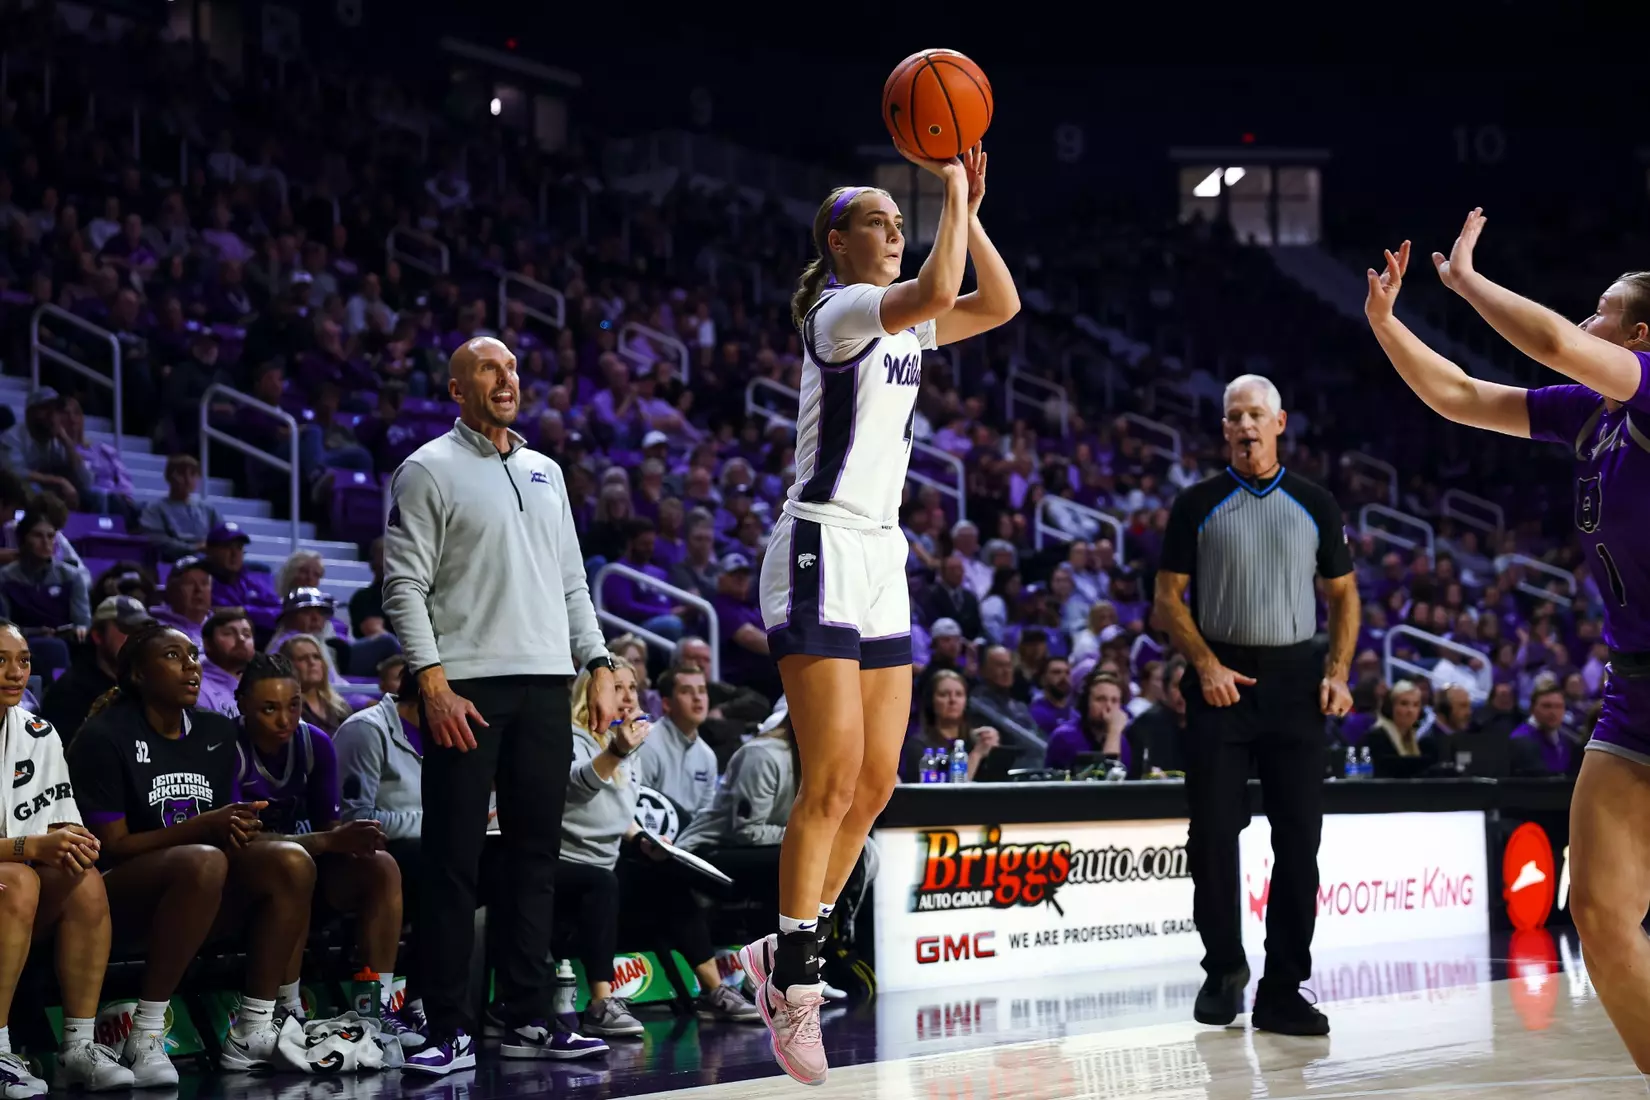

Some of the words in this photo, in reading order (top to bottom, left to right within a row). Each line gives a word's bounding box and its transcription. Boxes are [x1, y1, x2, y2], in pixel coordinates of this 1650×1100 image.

[1054, 123, 1084, 163] 9
[1453, 125, 1507, 163] 10
[135, 740, 151, 763] 32
[149, 783, 213, 803] ARKANSAS
[919, 891, 950, 910] AUTO
[952, 889, 994, 907] GROUP
[1314, 878, 1417, 917] MOOTHIE
[916, 931, 996, 964] GMC
[1009, 931, 1029, 949] WE
[1034, 927, 1059, 947] ARE
[1063, 919, 1158, 945] PROFESSIONAL
[1162, 916, 1198, 936] GRAD
